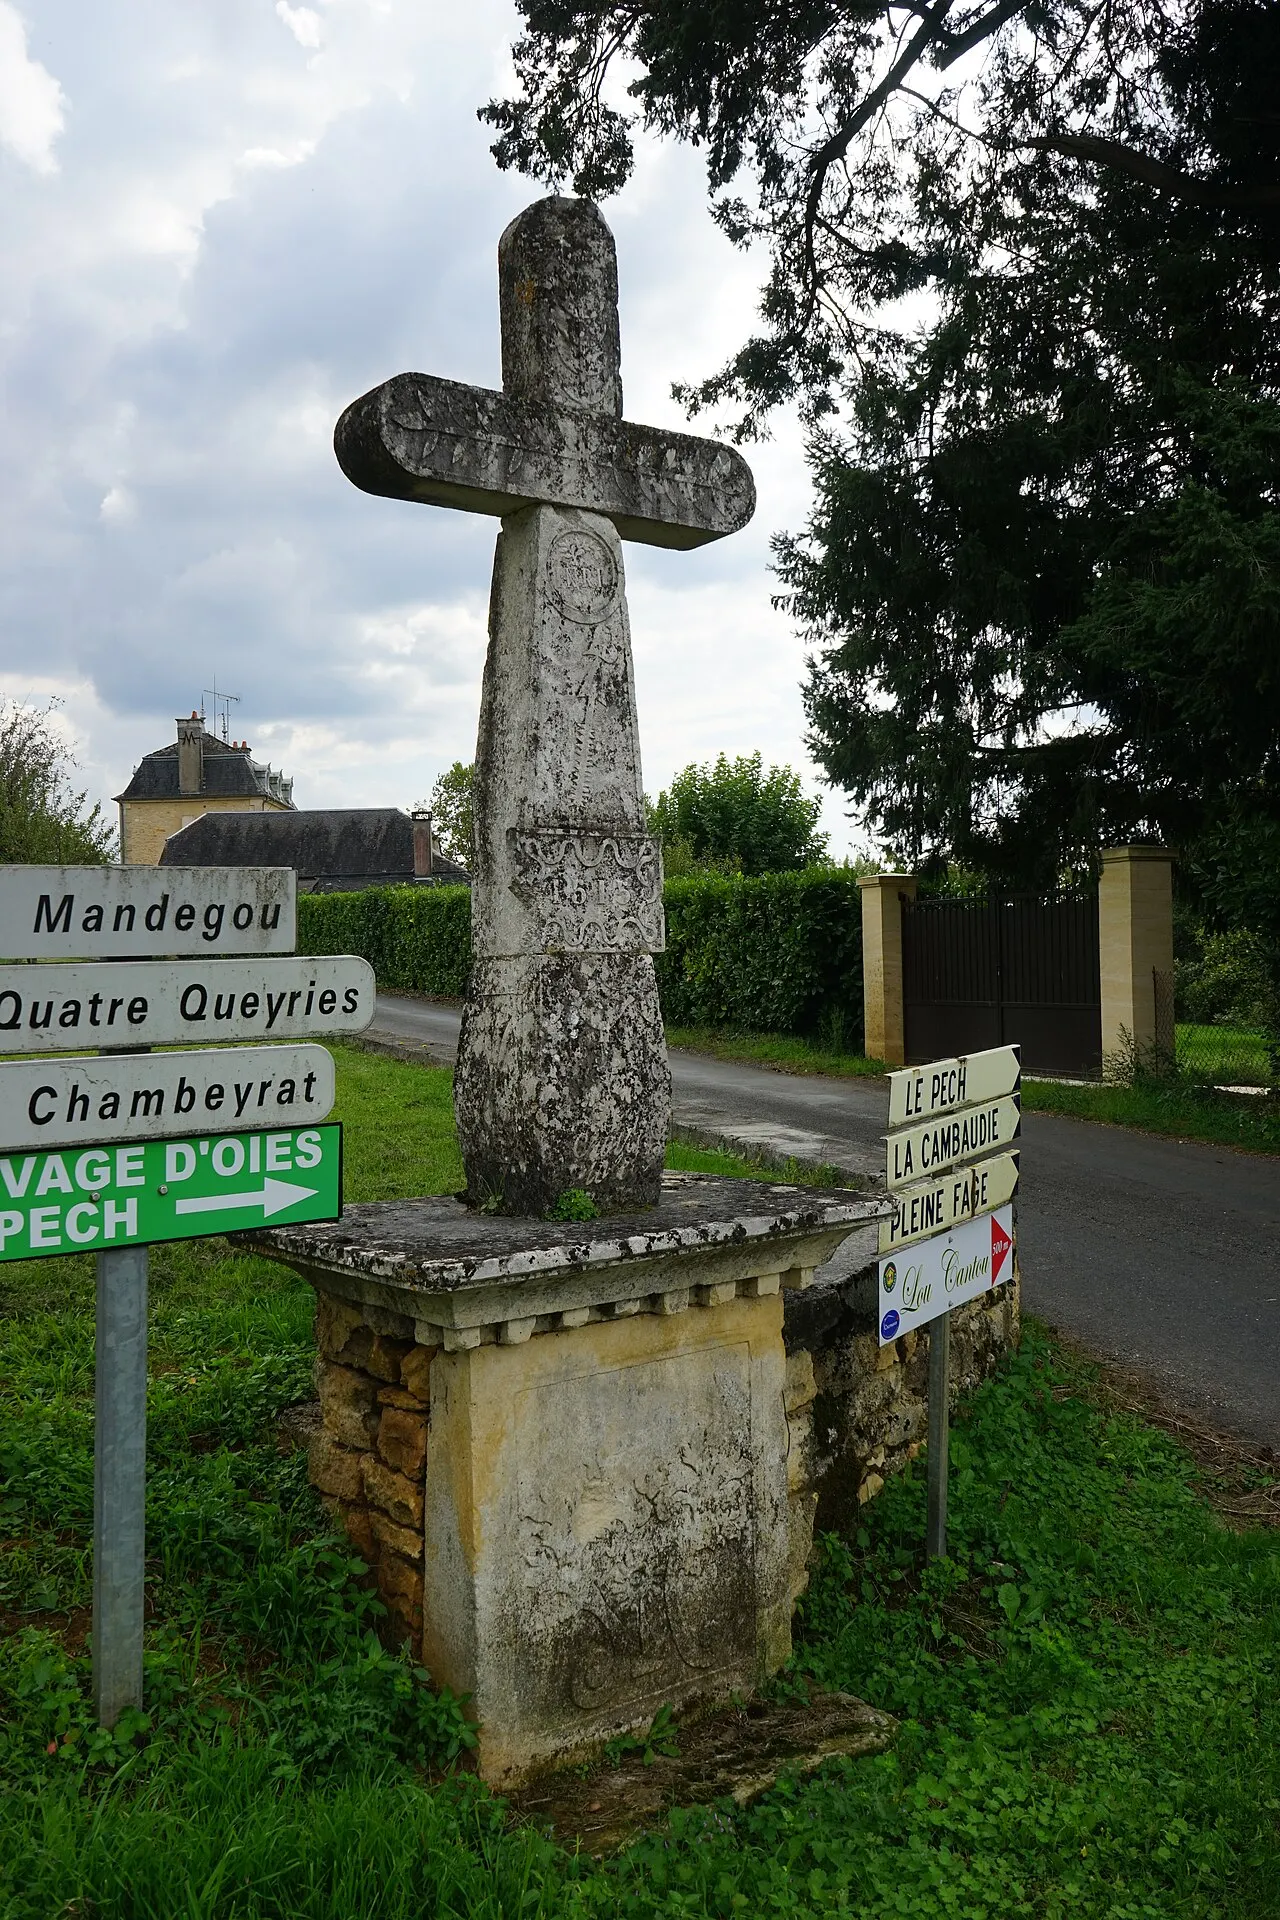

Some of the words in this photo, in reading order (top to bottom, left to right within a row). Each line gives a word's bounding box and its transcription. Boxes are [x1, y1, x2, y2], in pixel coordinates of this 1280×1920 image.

[33, 893, 282, 942] Mandegou
[0, 988, 149, 1031] Quatre
[179, 980, 360, 1029] Queyries
[28, 1071, 317, 1126] Chambeyrat
[905, 1077, 923, 1116] LE
[931, 1066, 967, 1111] PECH
[165, 1130, 322, 1183] D'OIES
[894, 1143, 914, 1180] LA
[921, 1107, 999, 1170] CAMBAUDIE
[0, 1198, 138, 1252] PECH
[890, 1188, 945, 1243] PLEINE
[900, 1263, 932, 1316] Lou
[941, 1248, 989, 1294] Cantou
